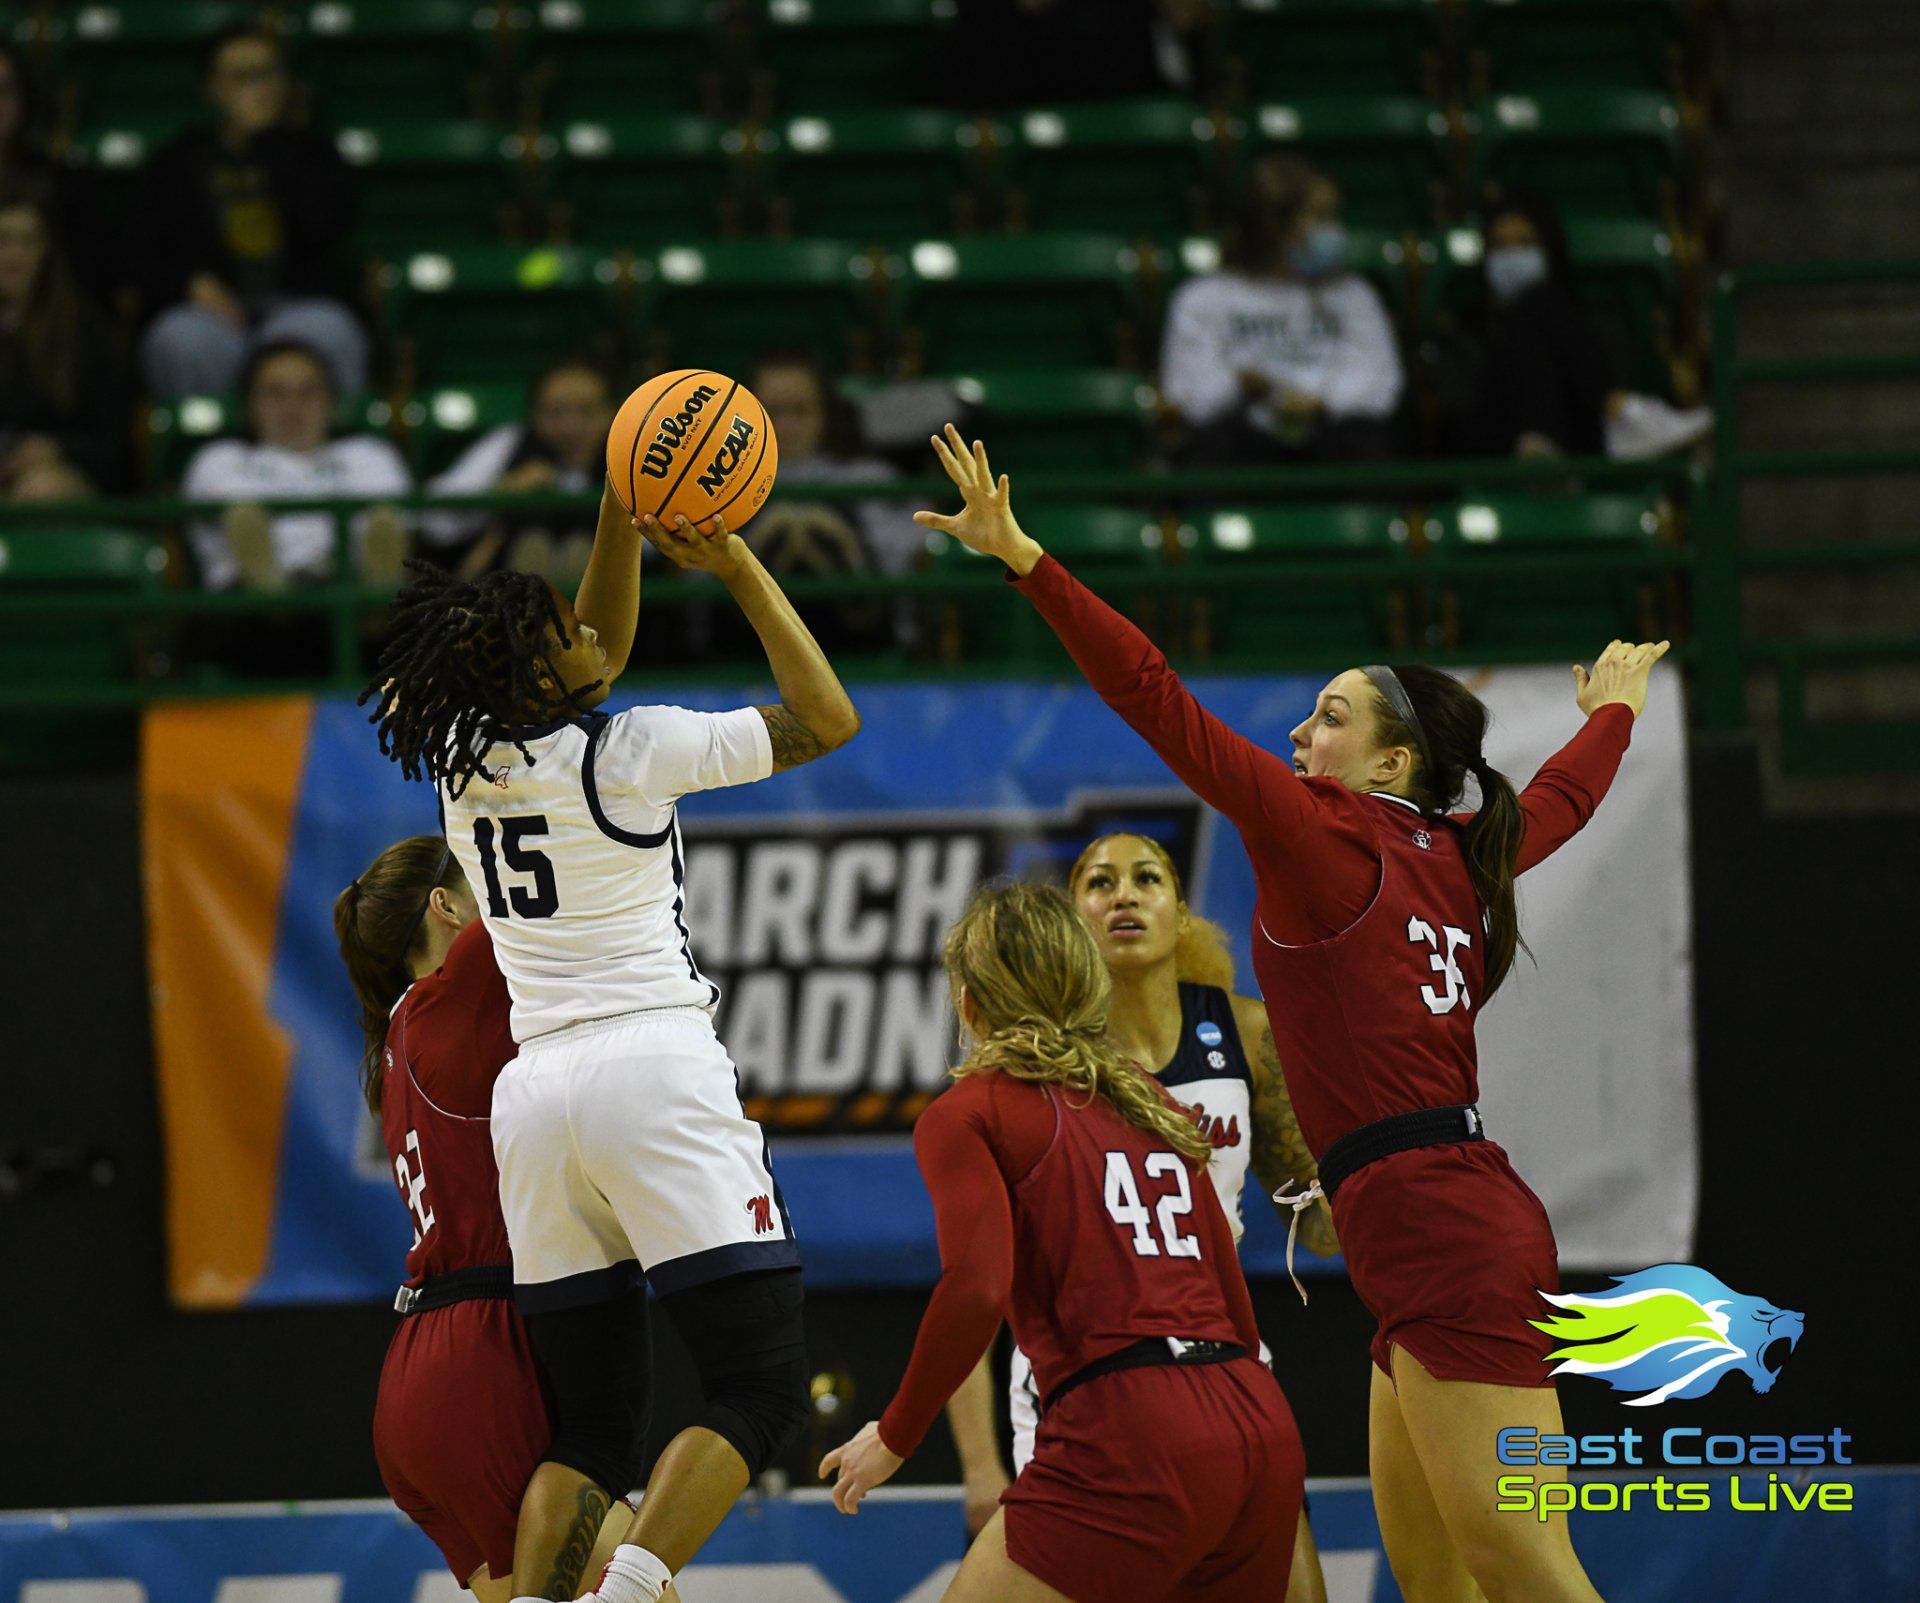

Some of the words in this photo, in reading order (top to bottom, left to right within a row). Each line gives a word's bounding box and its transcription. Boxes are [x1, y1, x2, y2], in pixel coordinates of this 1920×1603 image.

[640, 385, 719, 479] Wilson
[696, 415, 755, 497] NCAA
[473, 815, 559, 919] 15
[684, 835, 983, 968] ARCH
[1104, 1152, 1202, 1261] 42
